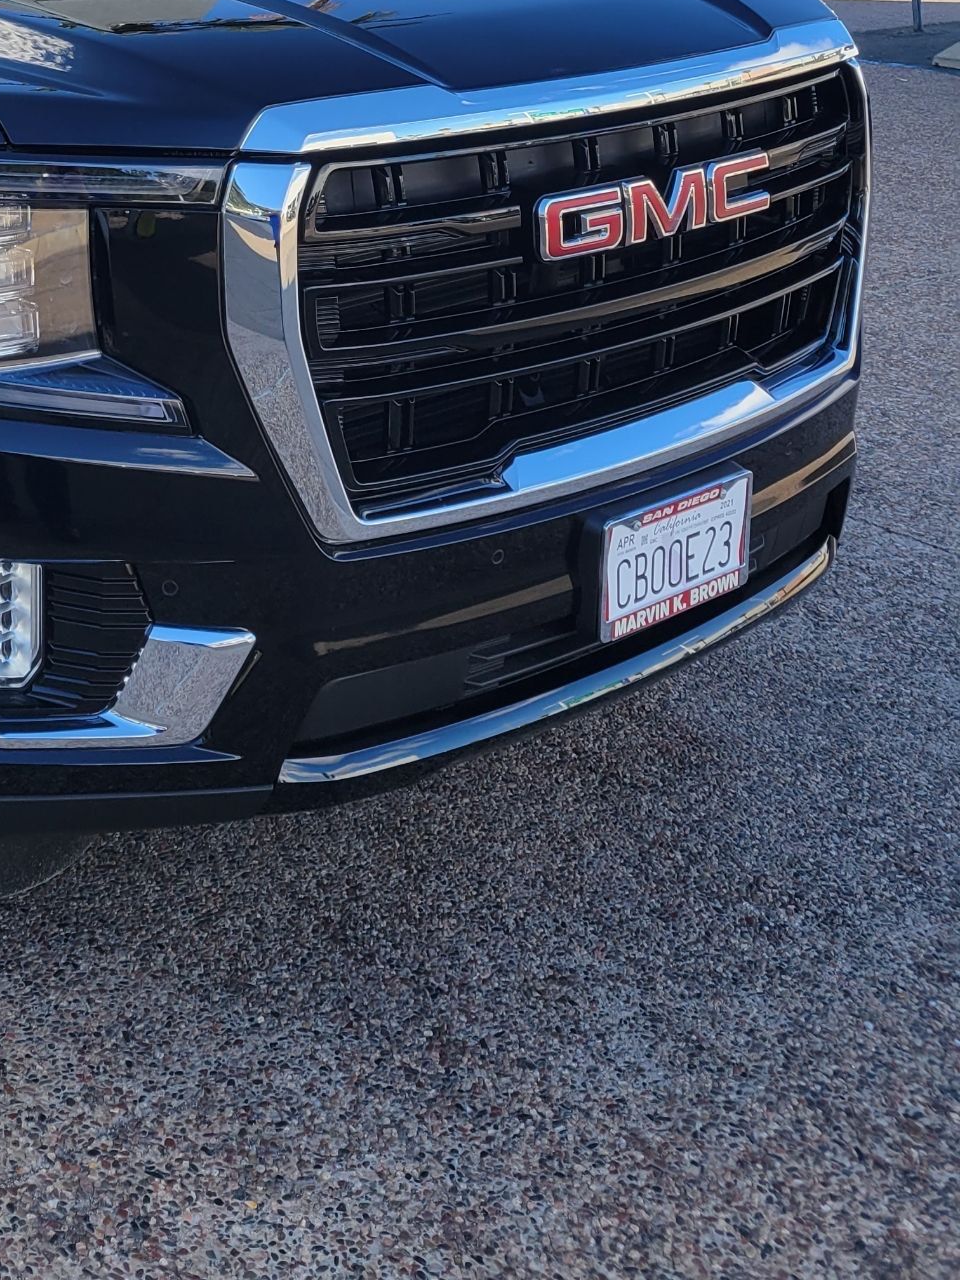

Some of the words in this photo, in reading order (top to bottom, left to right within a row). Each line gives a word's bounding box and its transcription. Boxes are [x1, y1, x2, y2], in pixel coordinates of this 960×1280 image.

[538, 148, 771, 261] GMC
[642, 506, 674, 524] SAN
[677, 488, 720, 510] DIEGO
[720, 499, 734, 510] 2021
[653, 510, 701, 536] California
[616, 534, 635, 551] APR
[614, 602, 671, 638] MARVIN
[673, 593, 687, 612] K.
[690, 570, 739, 603] BROWN
